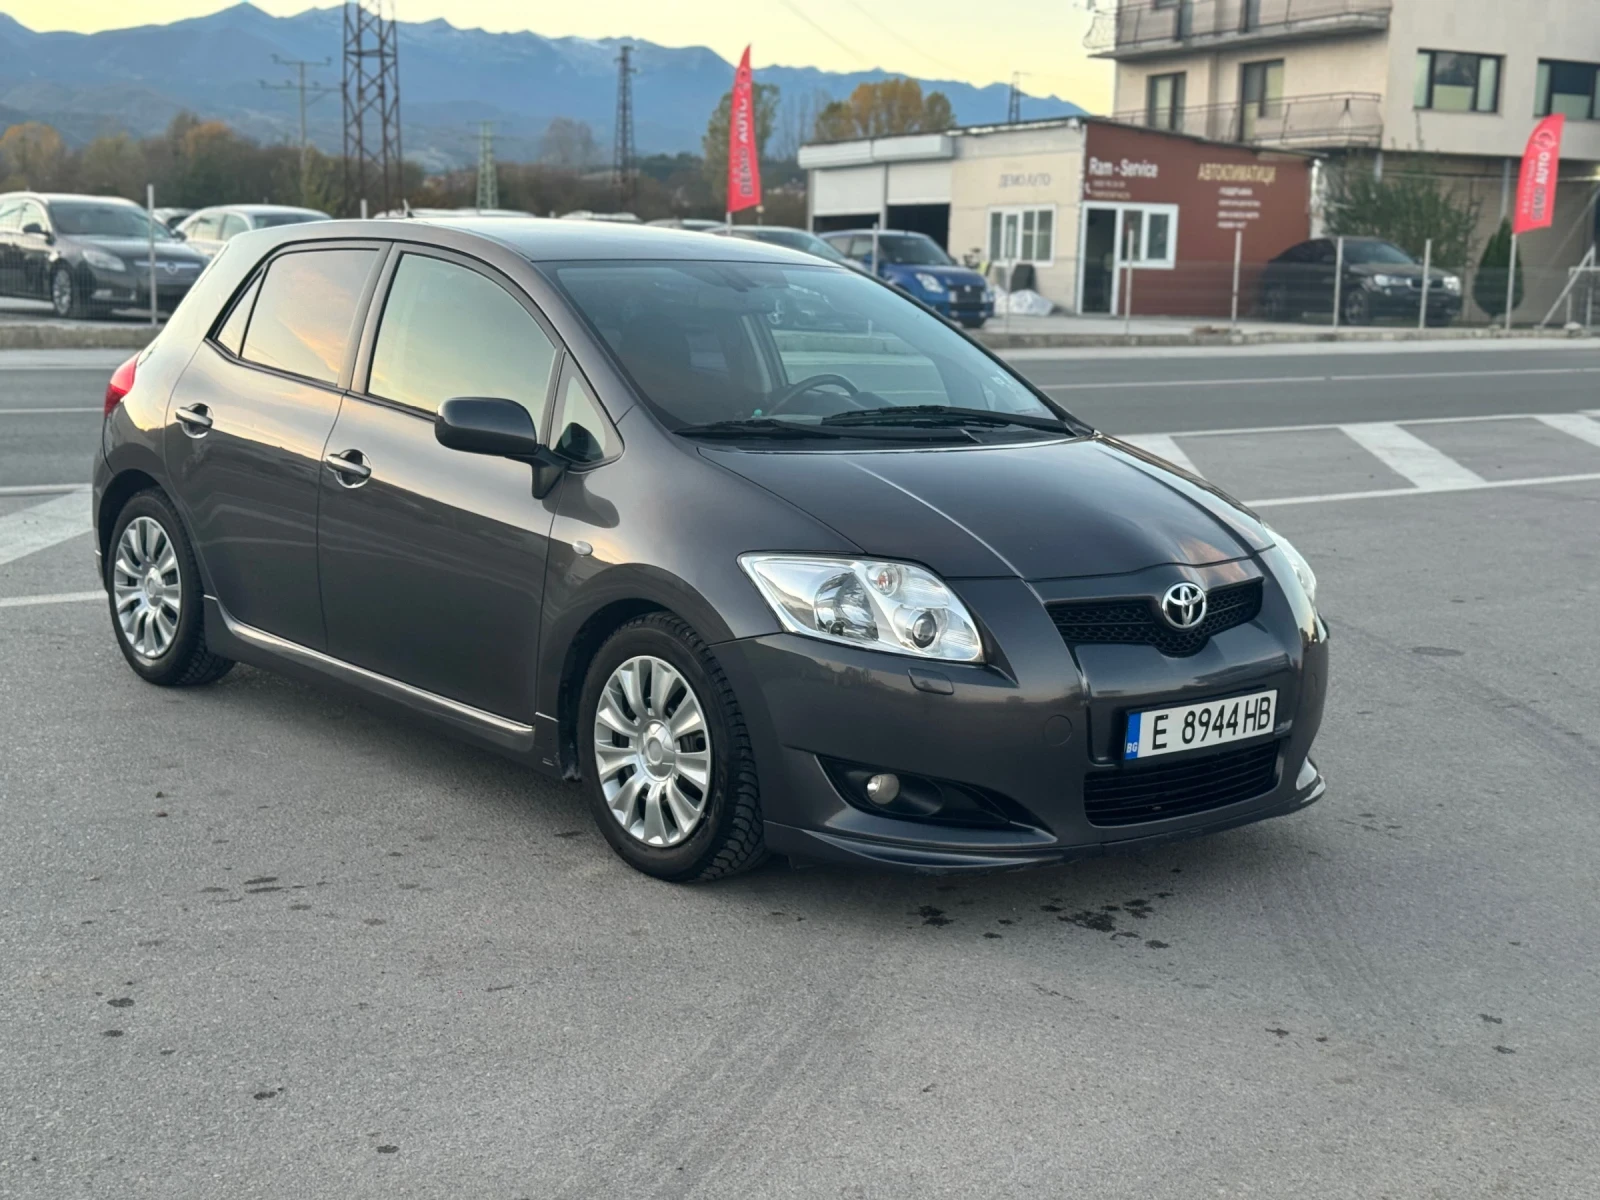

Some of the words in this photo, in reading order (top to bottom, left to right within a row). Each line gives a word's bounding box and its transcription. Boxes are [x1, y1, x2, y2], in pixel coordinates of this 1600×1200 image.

[1120, 158, 1159, 179] Service
[1536, 152, 1550, 185] AUTO
[1152, 713, 1169, 750] E
[1182, 702, 1239, 744] 8944
[1243, 696, 1271, 734] HB
[1126, 742, 1139, 753] BG
